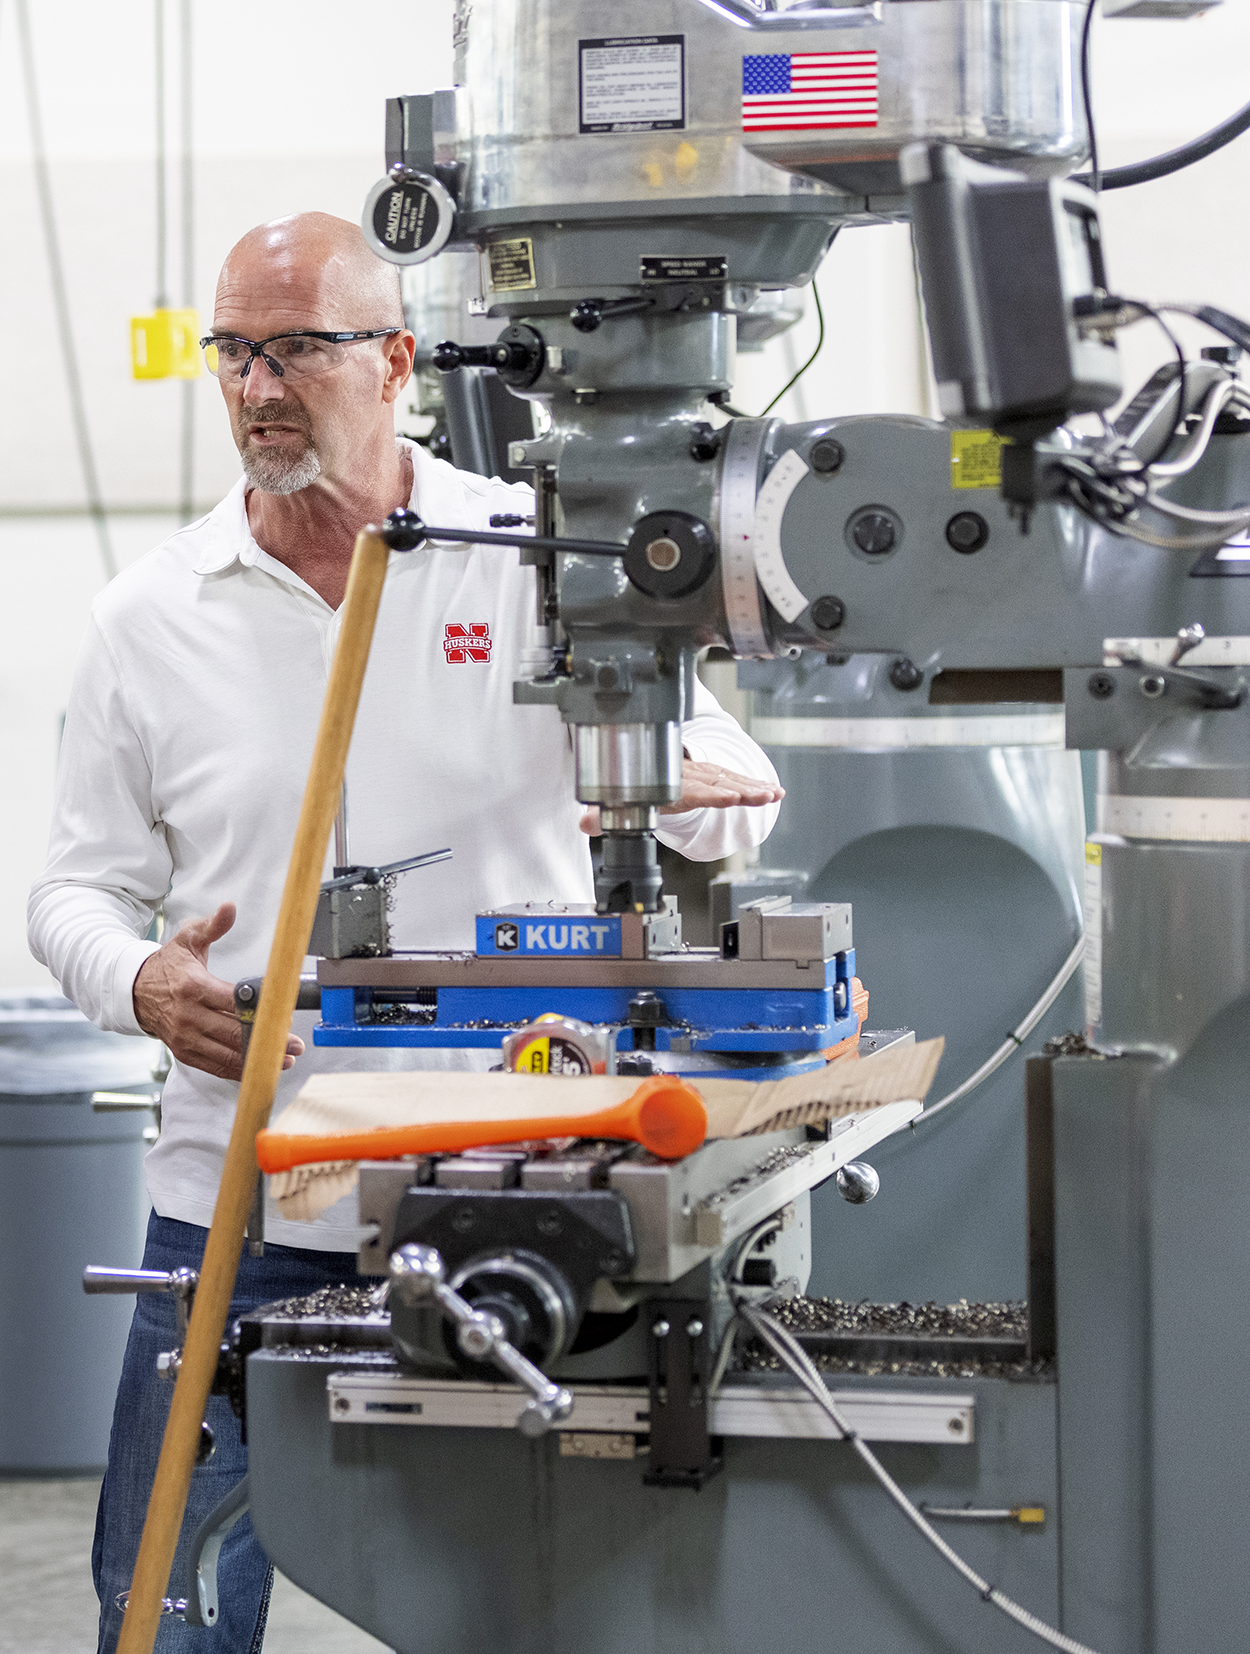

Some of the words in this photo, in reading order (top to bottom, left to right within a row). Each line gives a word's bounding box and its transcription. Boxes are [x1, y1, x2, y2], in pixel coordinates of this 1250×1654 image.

[384, 191, 402, 242] CAUTION
[399, 229, 407, 239] DO
[444, 638, 492, 650] HUSKERS
[526, 925, 610, 950] KURT
